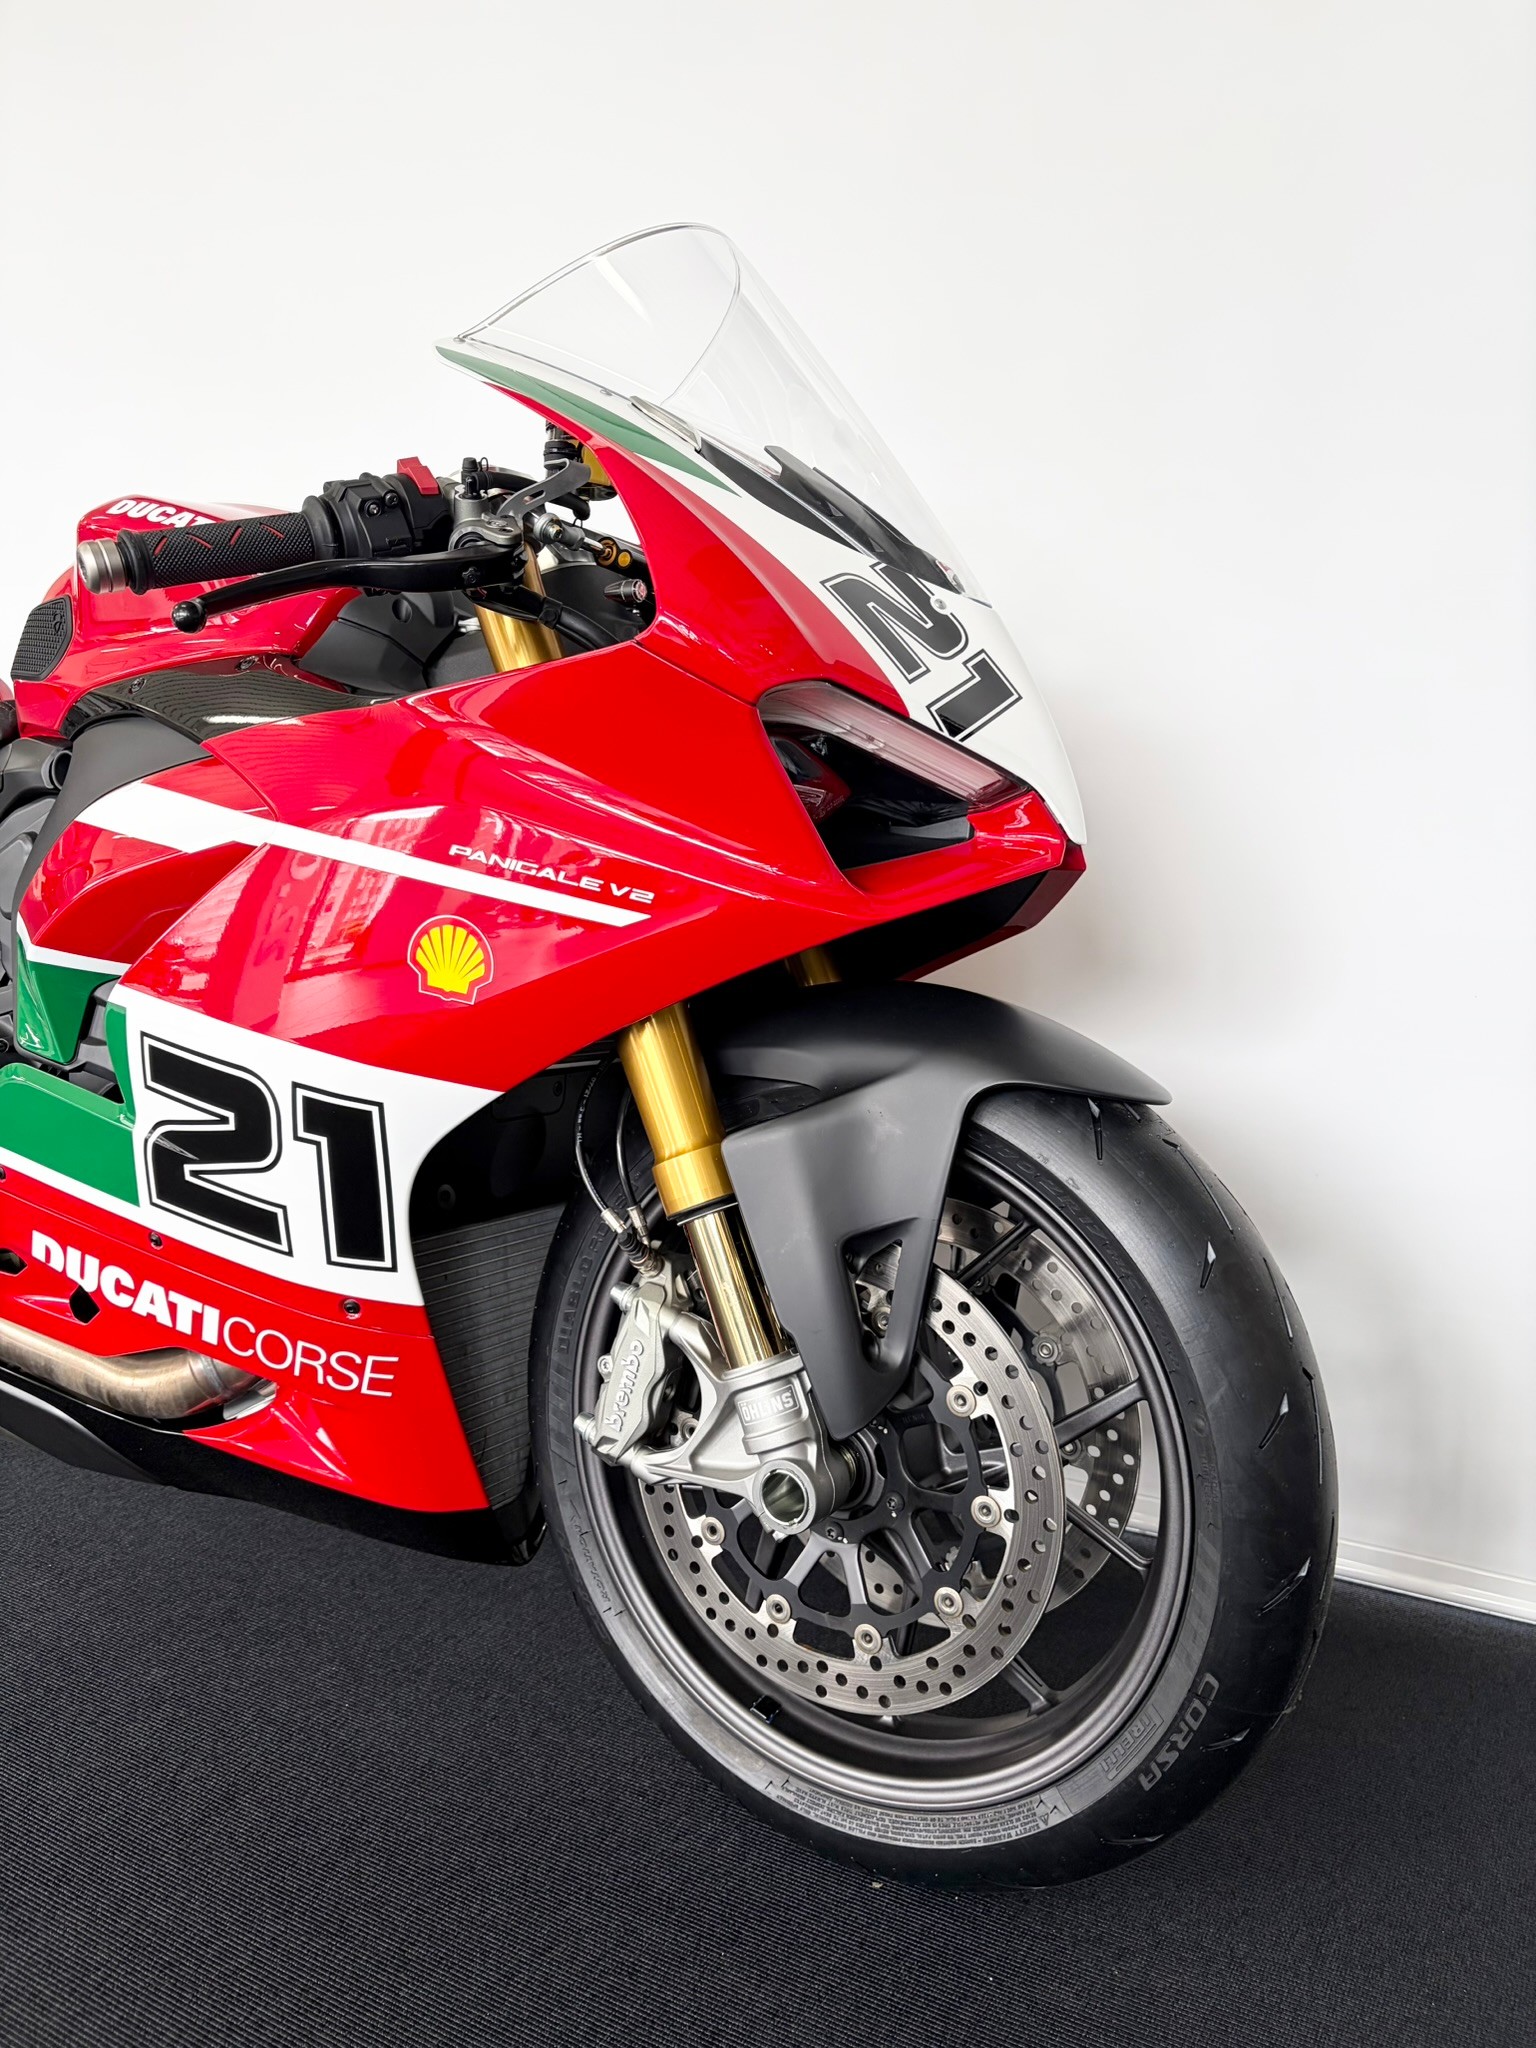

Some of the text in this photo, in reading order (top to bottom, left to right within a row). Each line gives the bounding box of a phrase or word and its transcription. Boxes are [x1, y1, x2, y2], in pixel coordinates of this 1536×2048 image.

[819, 562, 1022, 743] 21
[449, 844, 655, 904] PANIGALE V2
[140, 1031, 398, 1272] 21
[605, 1339, 644, 1432] brembo
[1099, 1703, 1164, 1781] PIRELLI
[1138, 1672, 1219, 1791] CORSA
